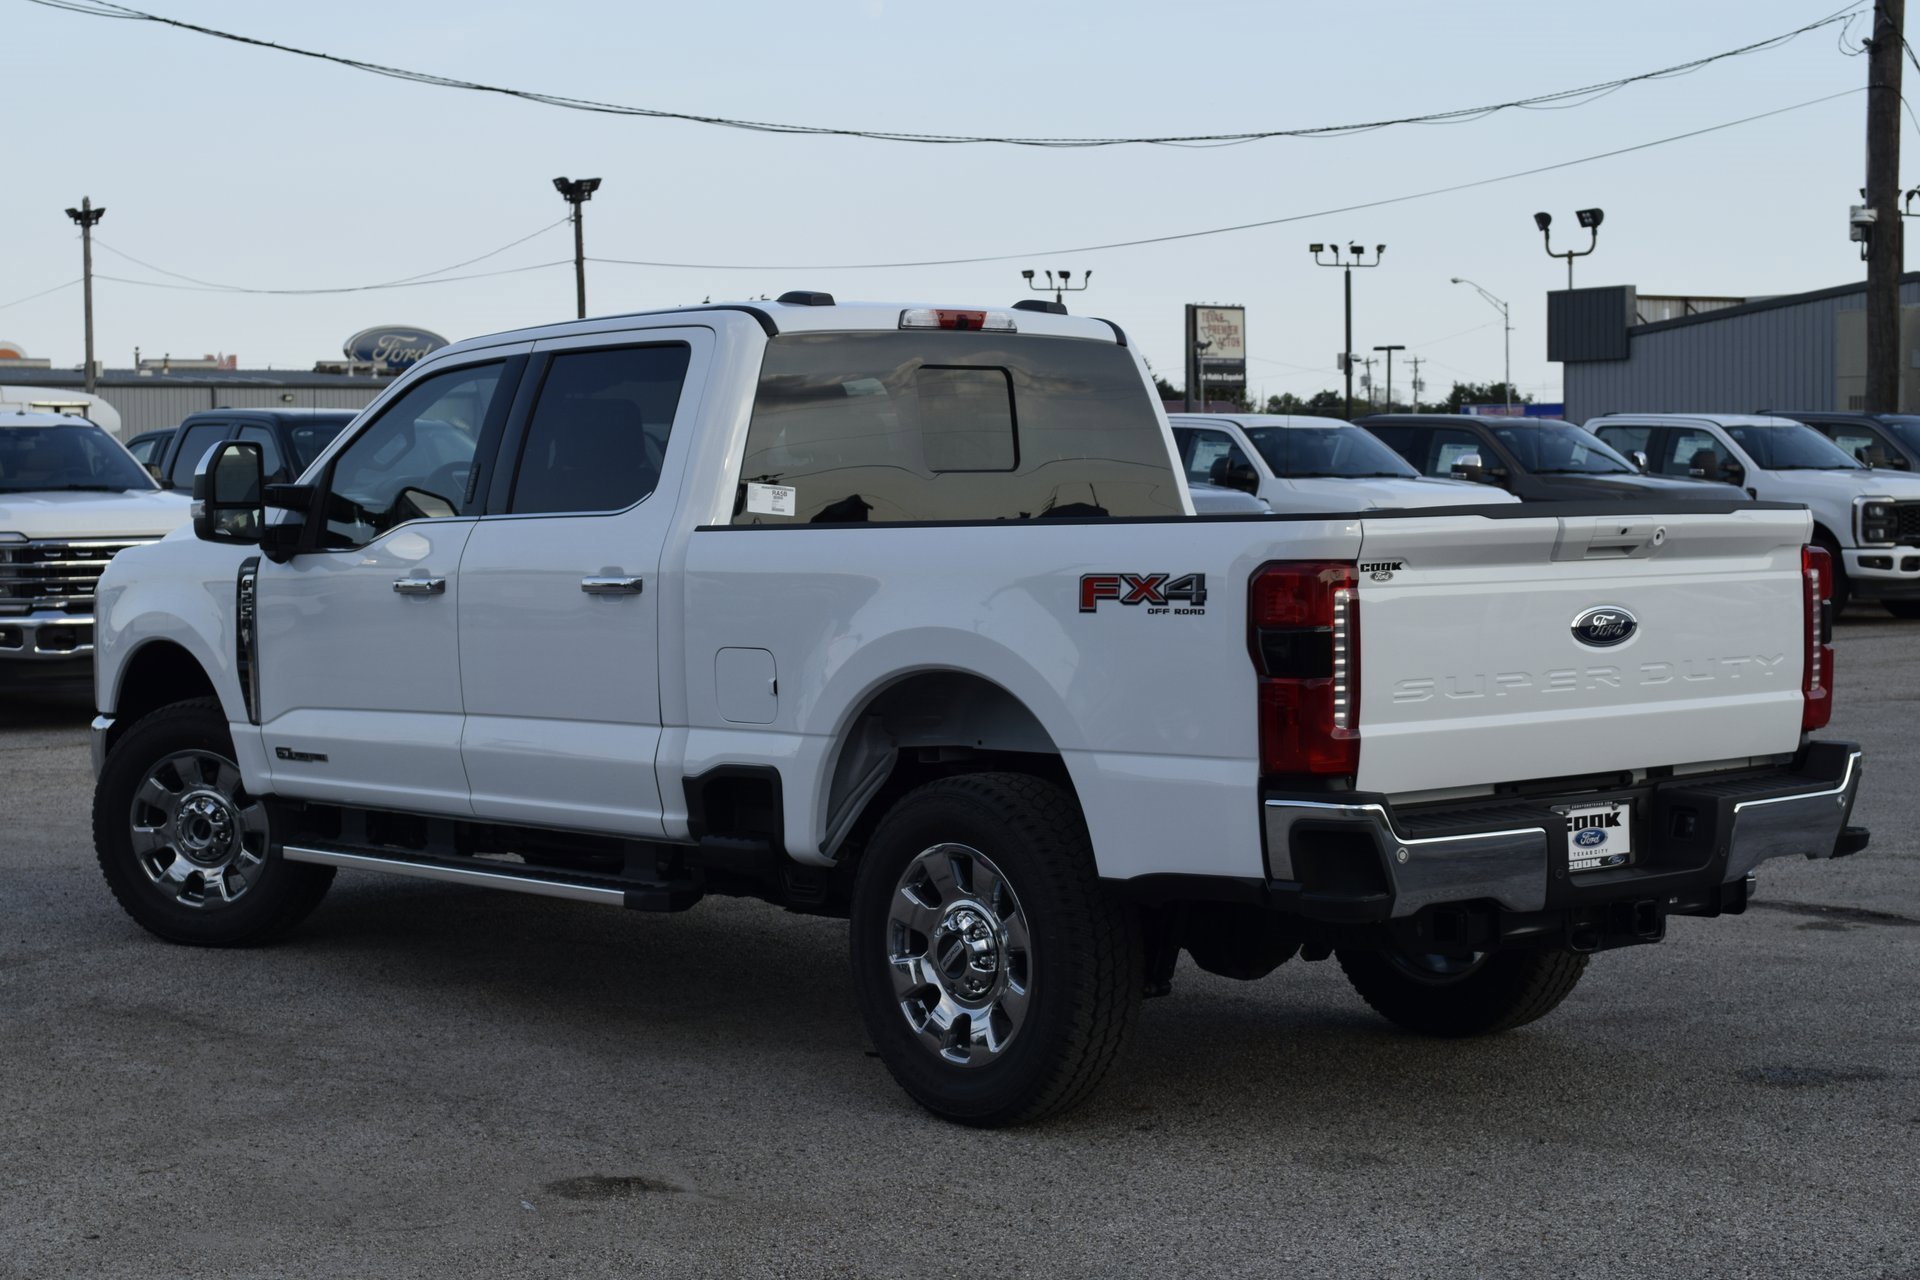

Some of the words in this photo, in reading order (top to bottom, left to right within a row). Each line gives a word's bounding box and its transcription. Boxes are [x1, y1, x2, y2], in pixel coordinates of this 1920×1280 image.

[372, 335, 433, 362] Ford
[1360, 562, 1403, 572] COOK
[1079, 573, 1207, 613] FX4
[1590, 615, 1625, 636] Ford
[1393, 665, 1621, 704] SUPER
[1640, 653, 1784, 685] DUTY
[1580, 831, 1600, 845] Ford
